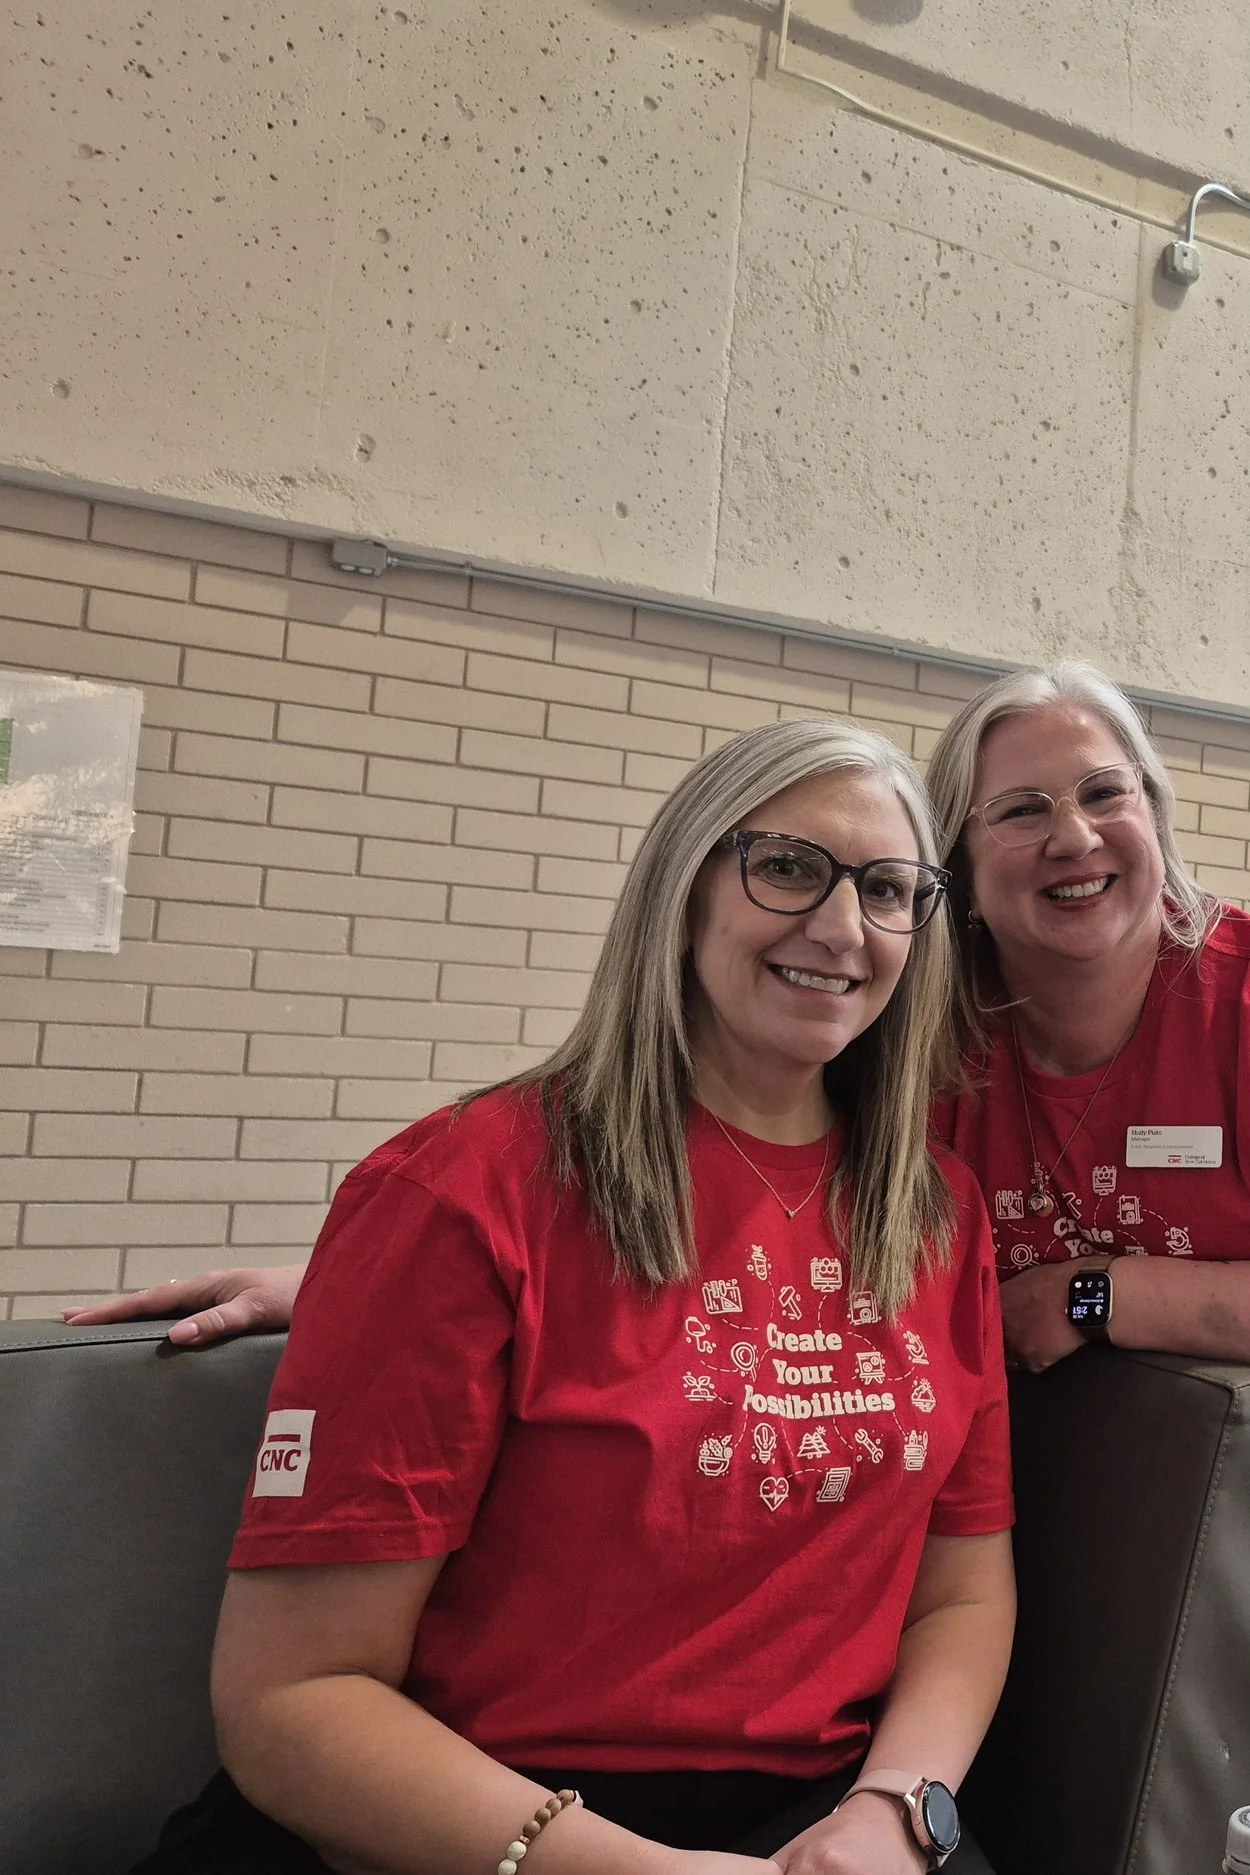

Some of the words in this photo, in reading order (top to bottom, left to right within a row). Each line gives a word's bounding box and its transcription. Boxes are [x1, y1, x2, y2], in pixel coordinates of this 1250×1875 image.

[1053, 1216, 1114, 1244] Crate
[767, 1322, 843, 1352] Create
[772, 1359, 834, 1386] Your
[743, 1384, 896, 1419] Possibilities
[260, 1449, 302, 1472] CNC
